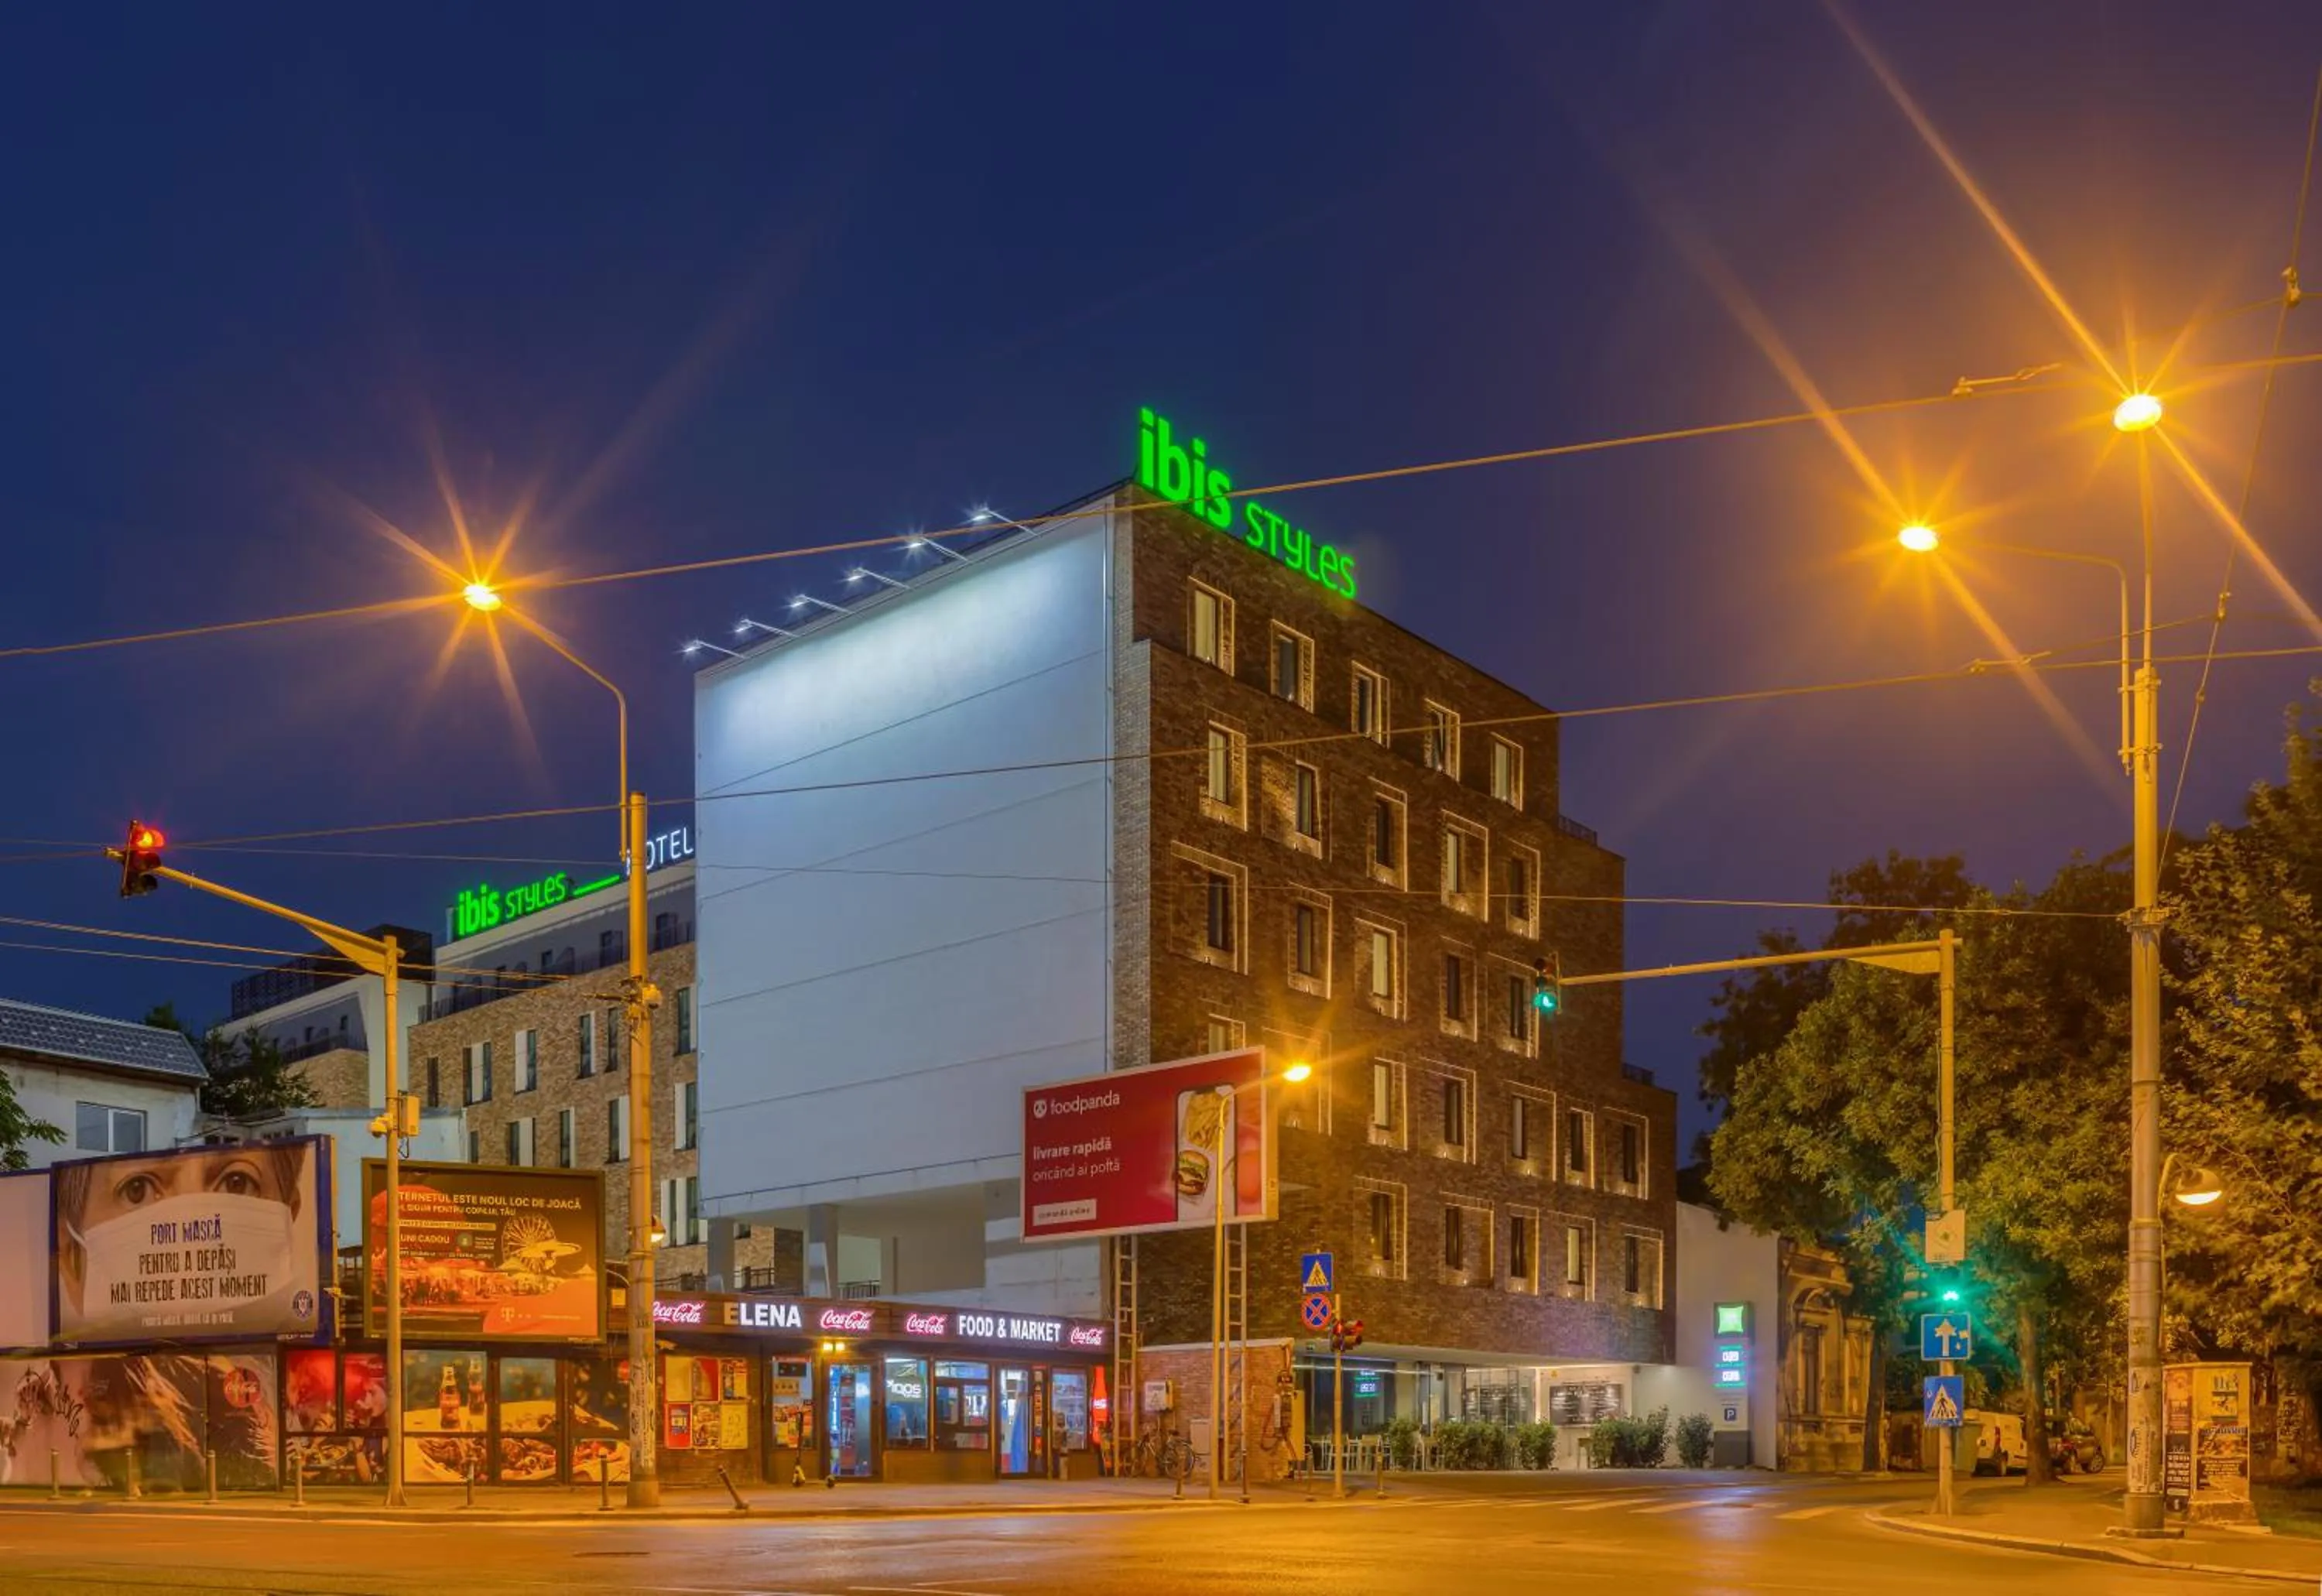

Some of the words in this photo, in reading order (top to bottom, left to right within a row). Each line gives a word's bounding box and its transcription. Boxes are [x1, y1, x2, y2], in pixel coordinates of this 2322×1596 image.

[1139, 406, 1232, 528] ibis
[626, 827, 694, 876] OTEL
[458, 883, 501, 935] ibis
[1050, 1089, 1121, 1115] foodpanda
[1033, 1146, 1070, 1160] livrare
[1072, 1136, 1112, 1157] rapidă
[399, 1191, 451, 1204] TERNETUL
[453, 1194, 478, 1205] ESTE
[479, 1196, 508, 1206] NOUL
[510, 1197, 529, 1207] LOC
[532, 1199, 546, 1208] DE
[546, 1197, 581, 1210] JOACĂ
[151, 1222, 176, 1245] PORT
[182, 1213, 222, 1243] MASCĂ
[400, 1234, 416, 1242] UNI
[139, 1252, 179, 1275] PENTRU
[184, 1250, 193, 1272] A
[111, 1281, 131, 1304] MAI
[135, 1279, 175, 1302] REPEDE
[180, 1278, 214, 1300] ACEST
[219, 1274, 268, 1298] MOMENT
[724, 1302, 802, 1327] ELENA
[820, 1310, 875, 1330] Coca-Cola
[906, 1313, 946, 1334] Coca-Cola
[958, 1314, 994, 1337] FOOD
[997, 1318, 1006, 1338] &
[1010, 1318, 1061, 1343] MARKET
